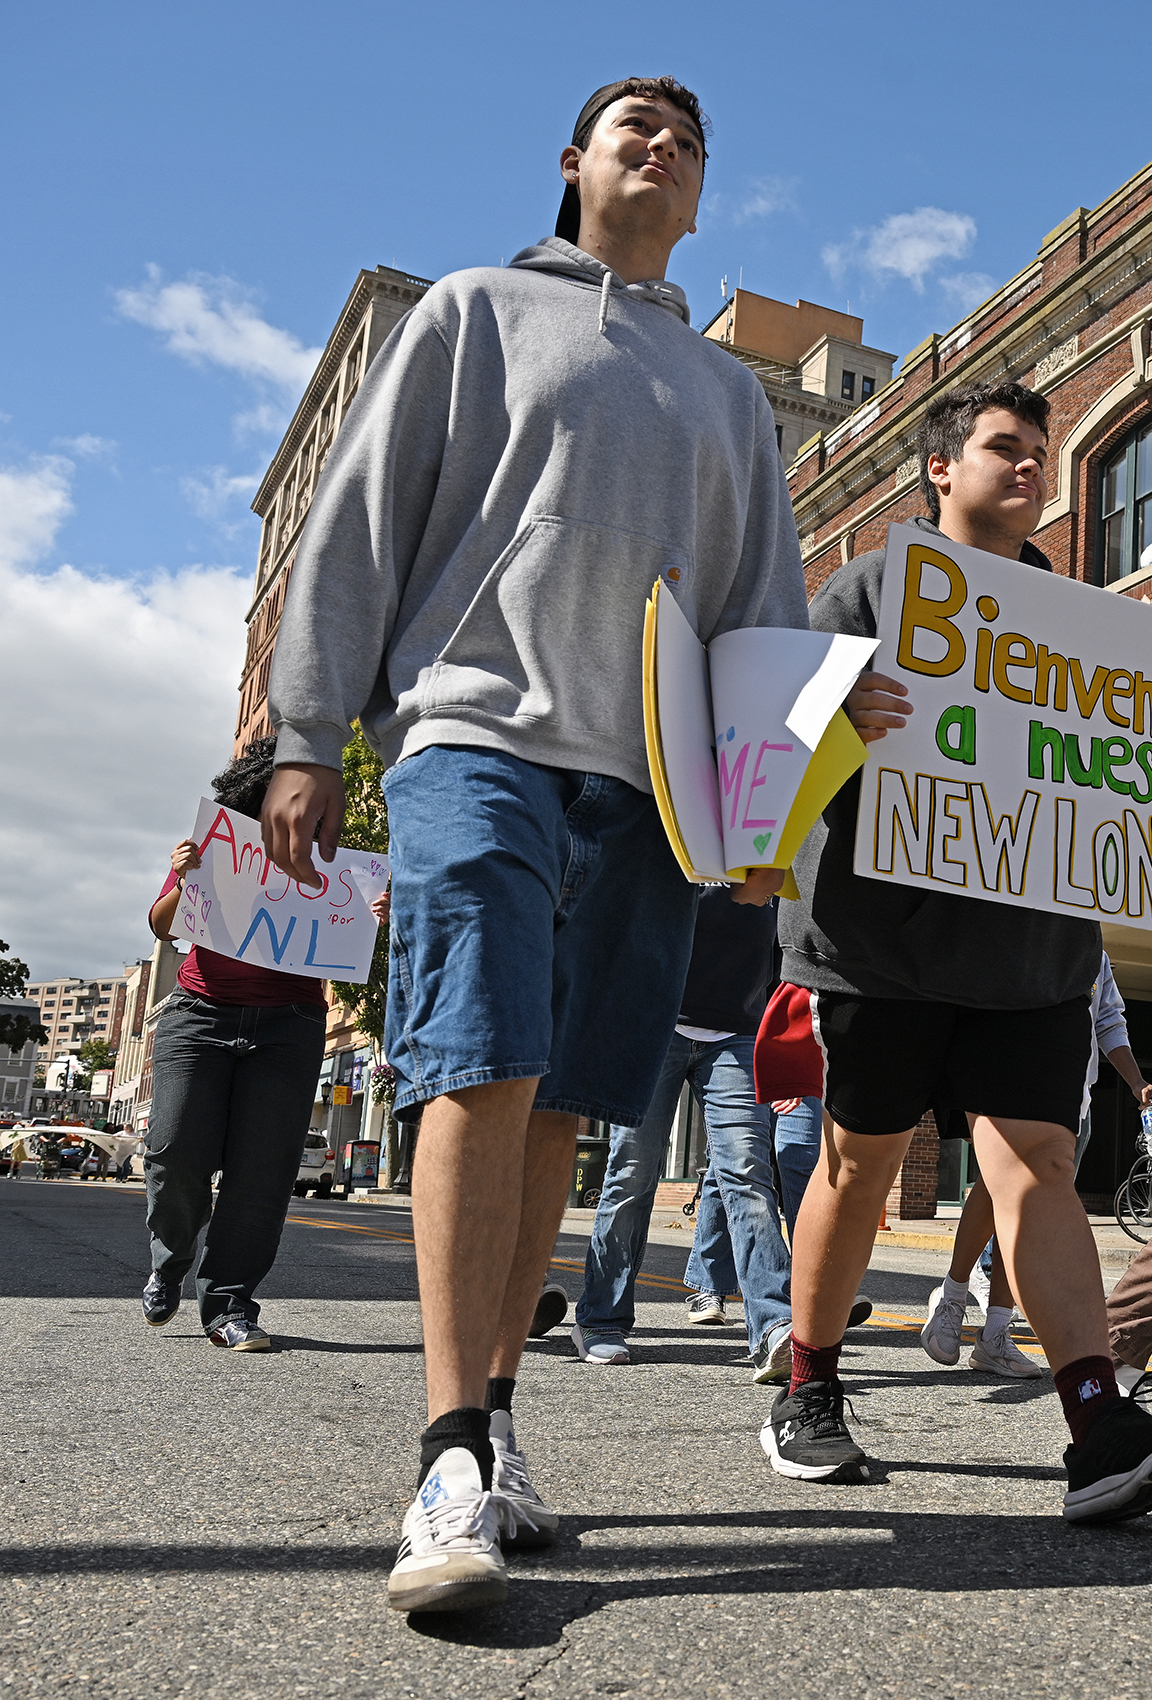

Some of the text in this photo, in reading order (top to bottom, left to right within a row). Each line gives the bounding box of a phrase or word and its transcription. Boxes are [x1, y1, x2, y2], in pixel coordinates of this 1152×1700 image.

[935, 705, 976, 765] a
[873, 767, 1041, 896] NEW
[331, 914, 354, 925] por
